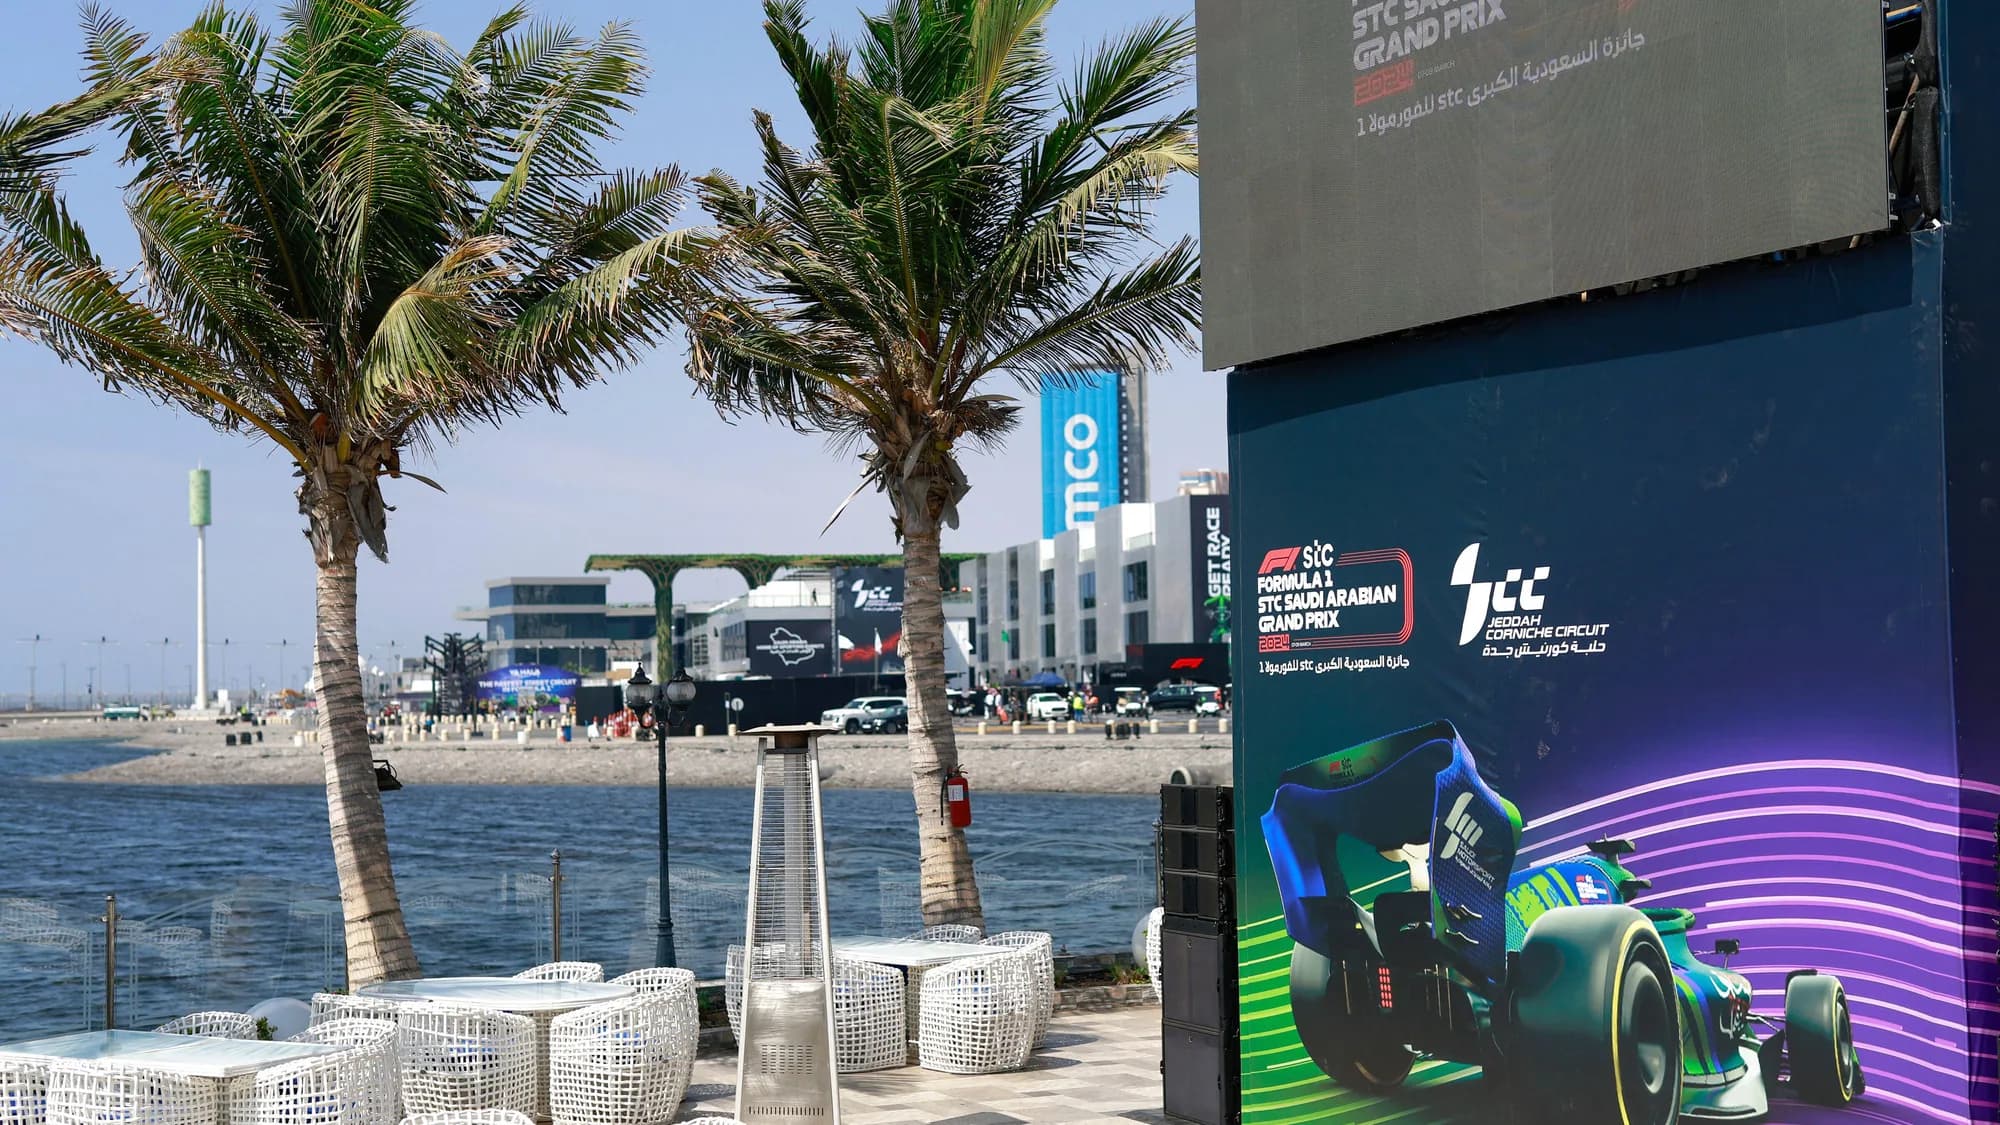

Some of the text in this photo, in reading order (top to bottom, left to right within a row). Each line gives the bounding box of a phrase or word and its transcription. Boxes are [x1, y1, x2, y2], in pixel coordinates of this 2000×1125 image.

[1352, 0, 1398, 40] STC
[1353, 0, 1507, 71] GRAND PRIX
[1602, 27, 1645, 59] جائزة
[1522, 38, 1598, 84] السعودية
[1438, 87, 1464, 112] stc
[1467, 68, 1519, 107] الكبرى
[1369, 93, 1435, 137] للفورمولا
[1206, 507, 1221, 598] GET RACE
[1257, 570, 1334, 594] FORMULA 1
[1258, 584, 1397, 614] STC SAUDI ARABIAN
[1258, 610, 1340, 633] GRAND PRIX
[1485, 624, 1610, 640] CORNICHE CIRCUIT
[1488, 614, 1541, 628] JEDDAH
[1259, 634, 1290, 652] 2024
[1259, 654, 1410, 676] جائزة السعودية الكبرى stc للفورمولا 1
